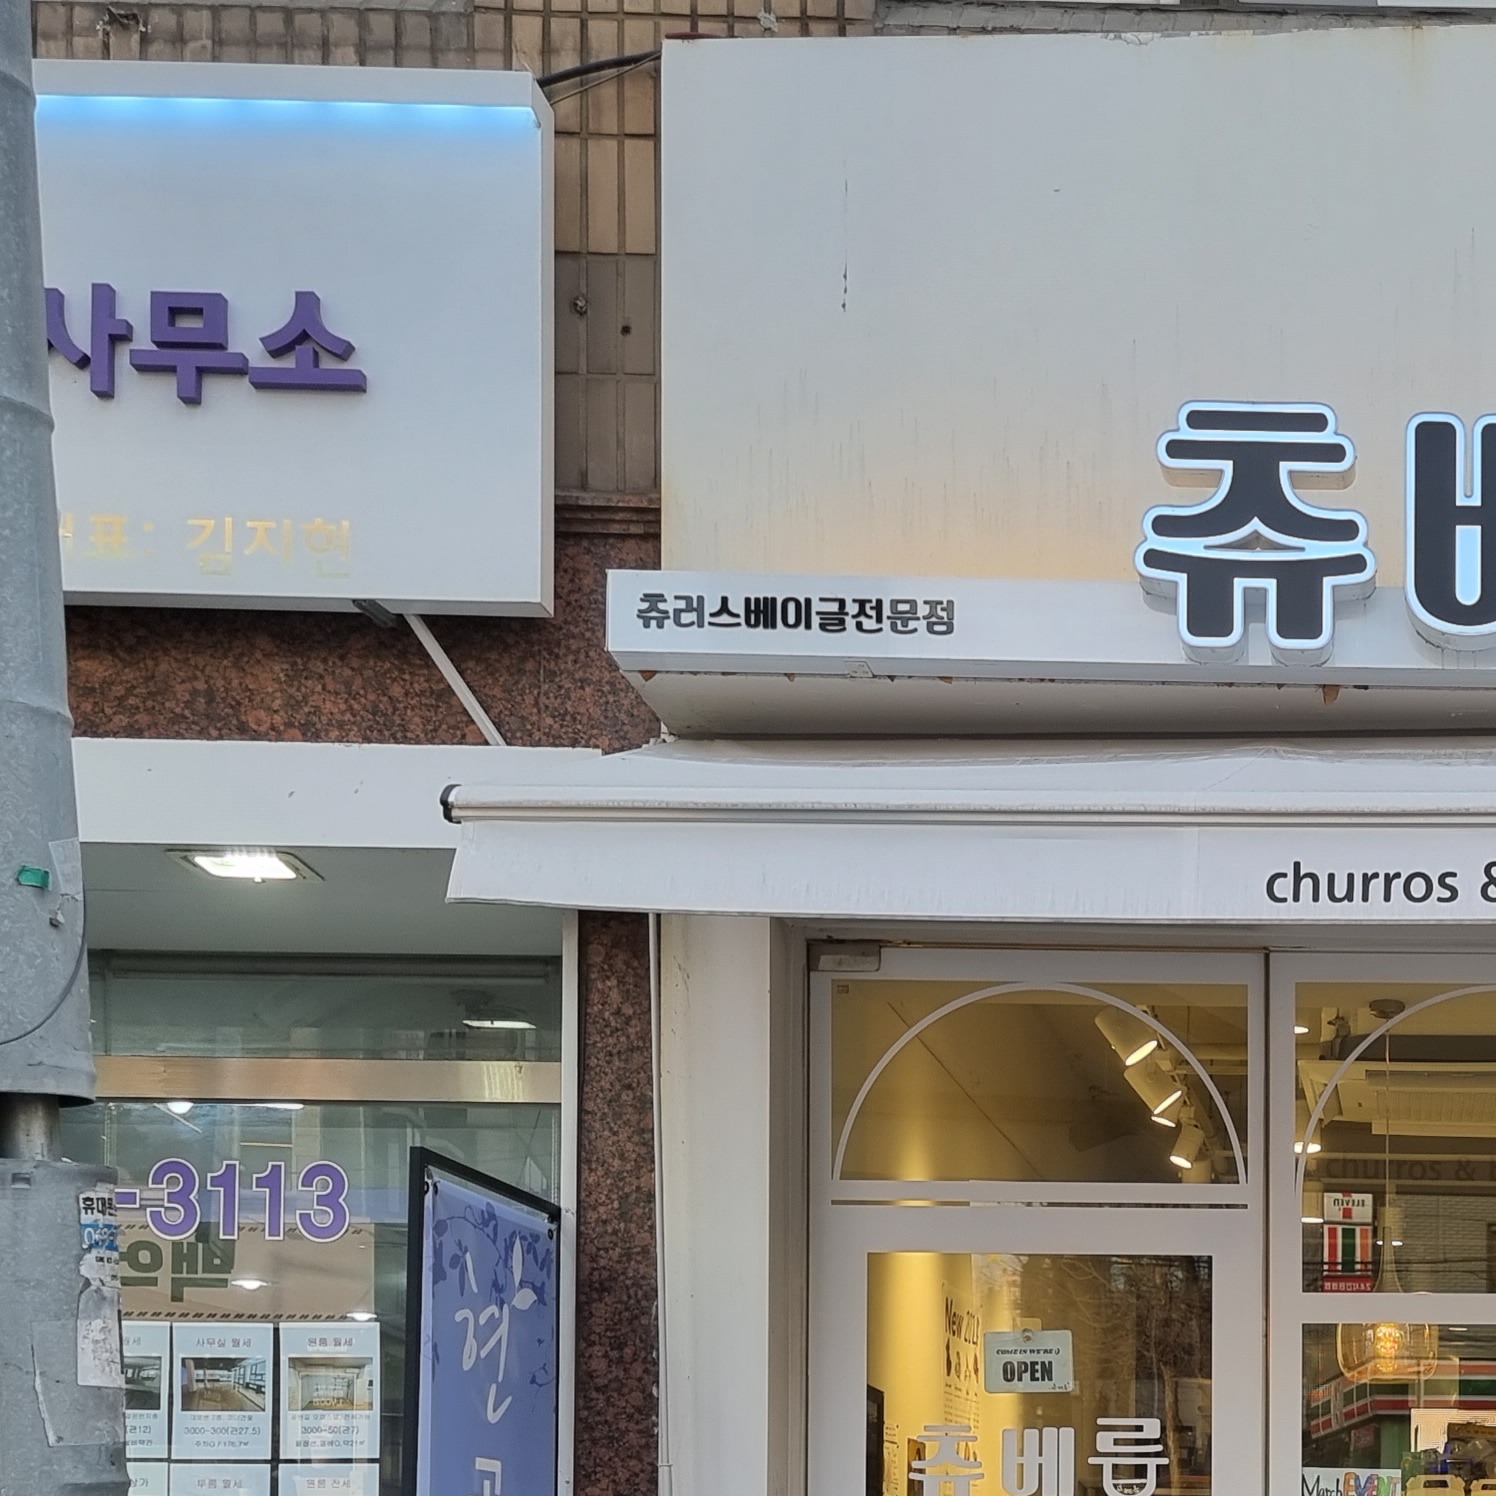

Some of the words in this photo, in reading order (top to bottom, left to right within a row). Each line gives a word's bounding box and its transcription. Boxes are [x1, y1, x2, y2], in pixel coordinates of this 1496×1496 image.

[636, 592, 956, 635] 츄러스베이글전문점
[1266, 861, 1459, 904] churros
[1002, 1360, 1053, 1383] OPEN
